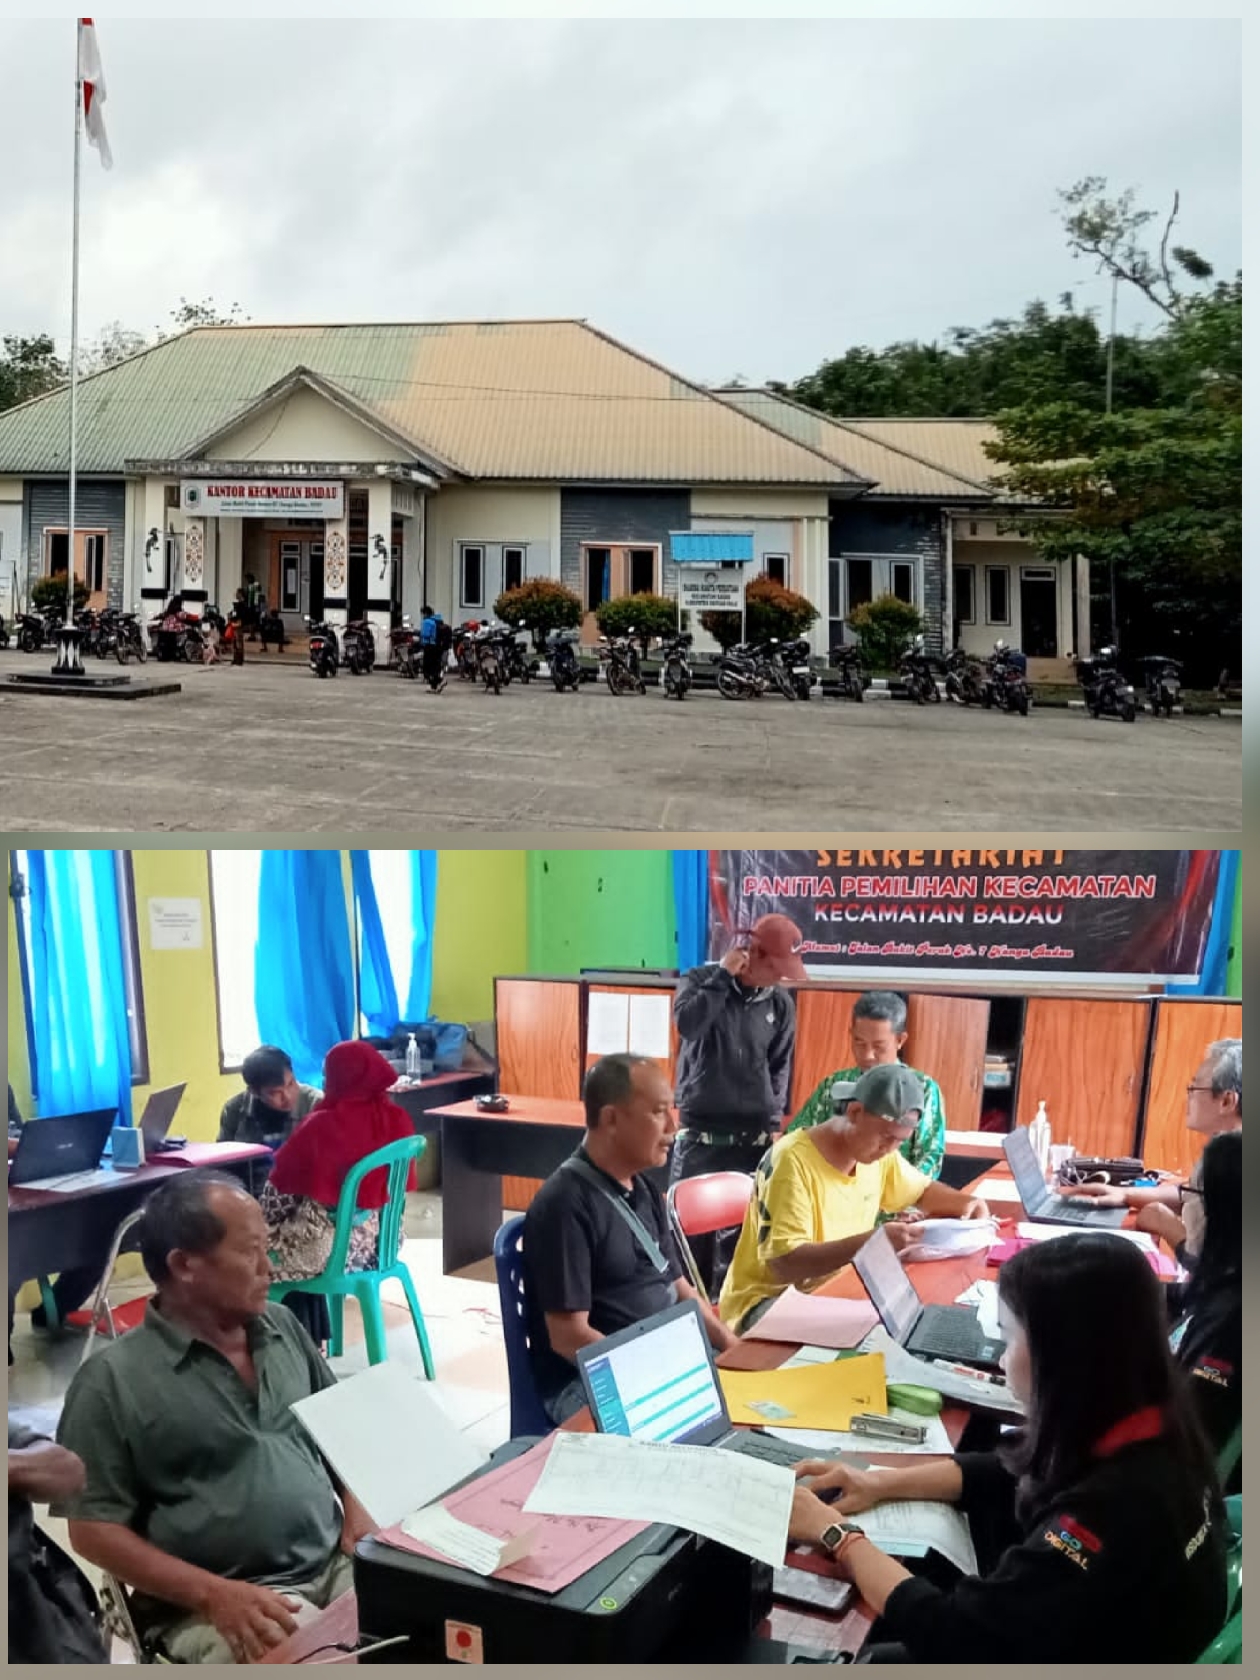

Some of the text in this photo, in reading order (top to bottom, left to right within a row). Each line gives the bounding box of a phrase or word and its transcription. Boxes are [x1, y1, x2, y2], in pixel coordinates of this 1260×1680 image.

[207, 486, 336, 499] KANTOR KECAMATAN BADAU
[743, 875, 1156, 898] PANITIA PEMILIHAN KECAMATAN
[814, 903, 1064, 924] KECAMATAN BADAU
[1044, 1531, 1088, 1570] DIGITAL
[1060, 1531, 1082, 1550] GO
